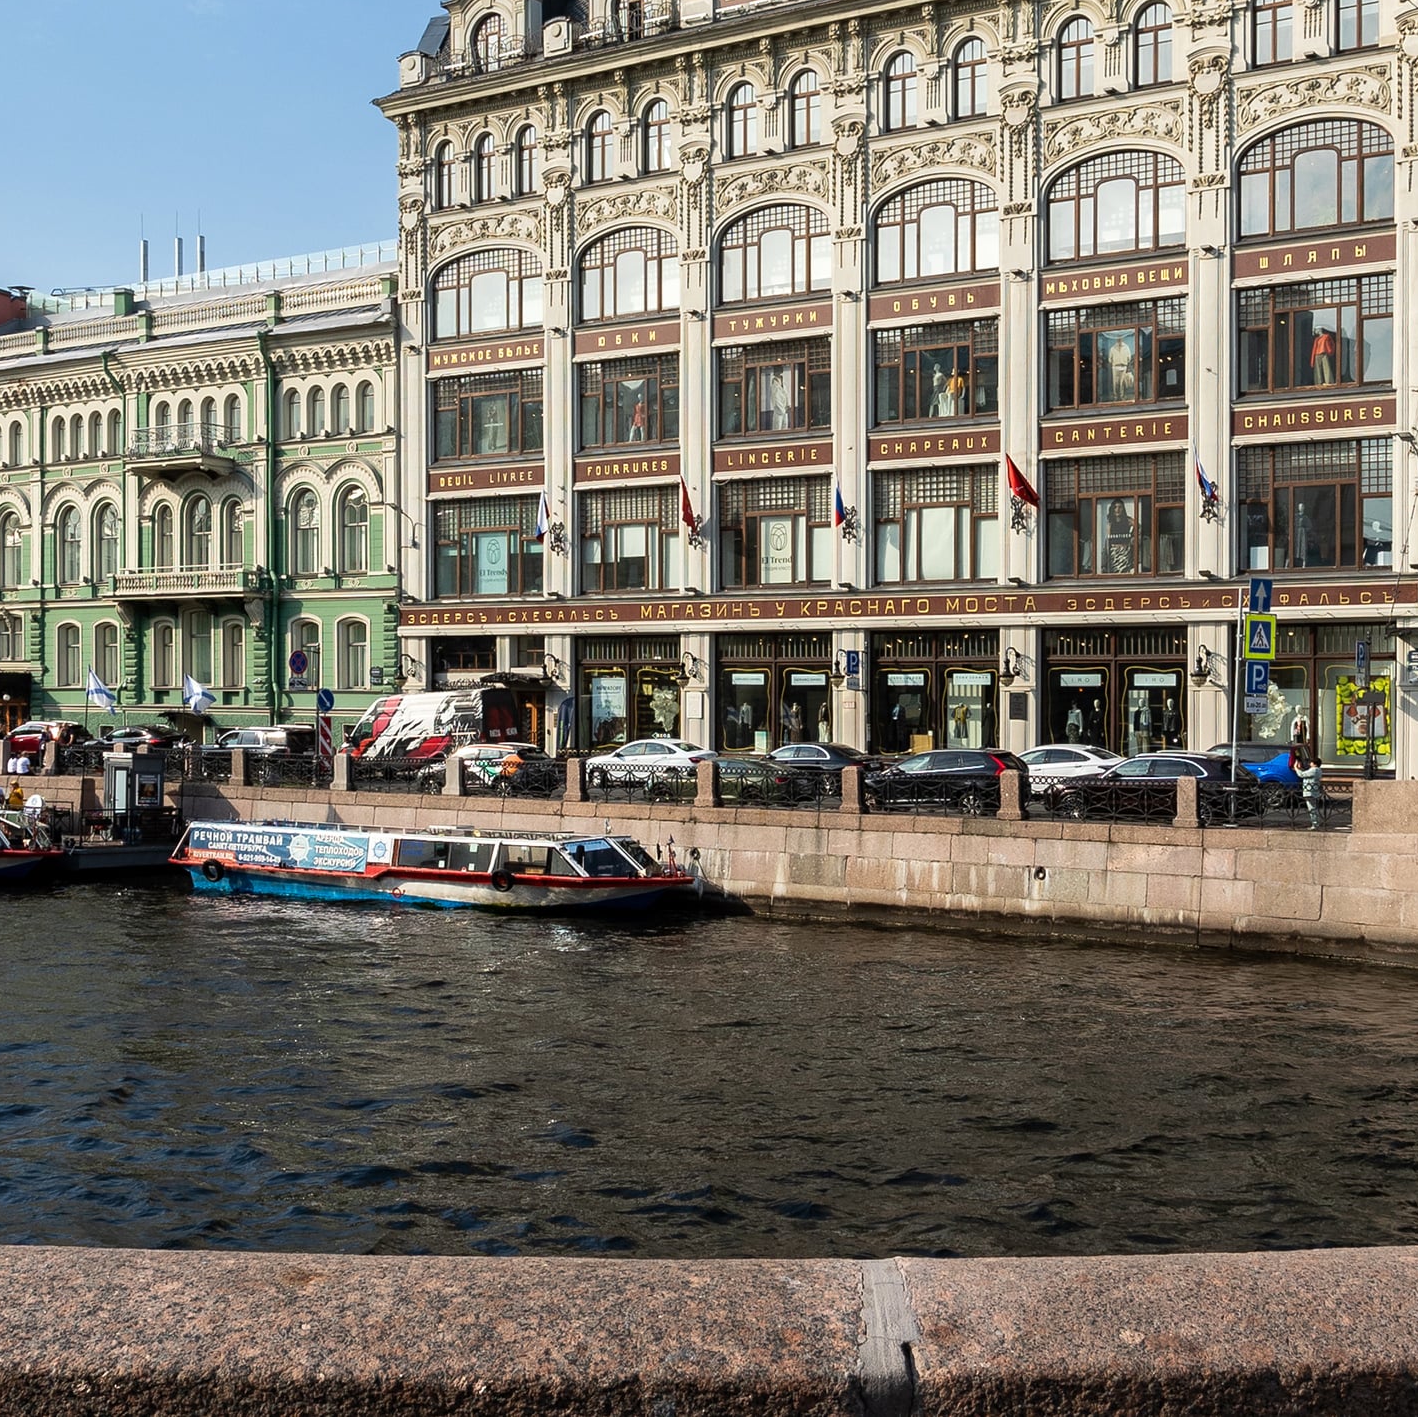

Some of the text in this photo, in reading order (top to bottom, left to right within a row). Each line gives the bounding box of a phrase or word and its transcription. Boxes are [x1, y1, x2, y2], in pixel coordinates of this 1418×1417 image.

[1259, 244, 1368, 270] ШЛЯПЫ
[1137, 267, 1184, 285] ВЕЩИ
[893, 292, 975, 313] ОБУВЬ
[729, 313, 818, 331] ТУЖУРКИ
[598, 330, 656, 347] ЮБКИ
[434, 349, 491, 365] МУЖСКОЕ
[1244, 406, 1384, 429] CHAUSSURES
[1055, 422, 1172, 443] GANTERIE
[880, 436, 988, 455] CHAPEAUX
[727, 448, 818, 466] LINGERIE
[587, 460, 669, 476] FOURRURES
[439, 470, 534, 487] DEUIL LIVREE
[408, 612, 488, 625] ЭСДЕРСЪ
[508, 610, 620, 623] СХЕФАЛЬСЪ
[640, 602, 761, 619] МАГАЗИНЪ
[775, 602, 786, 617] У
[800, 598, 930, 615] КРАСНАГО
[945, 595, 1038, 613] МОСТА
[1067, 596, 1191, 611] ЭСДЕРСЪ
[1221, 592, 1396, 608] СХФАЛЬСЪ
[1253, 665, 1265, 690] P
[194, 830, 283, 846] РЕЧНОЙ ТРАМВАЙ
[314, 846, 364, 857] ТЕПЛОХОДОВ
